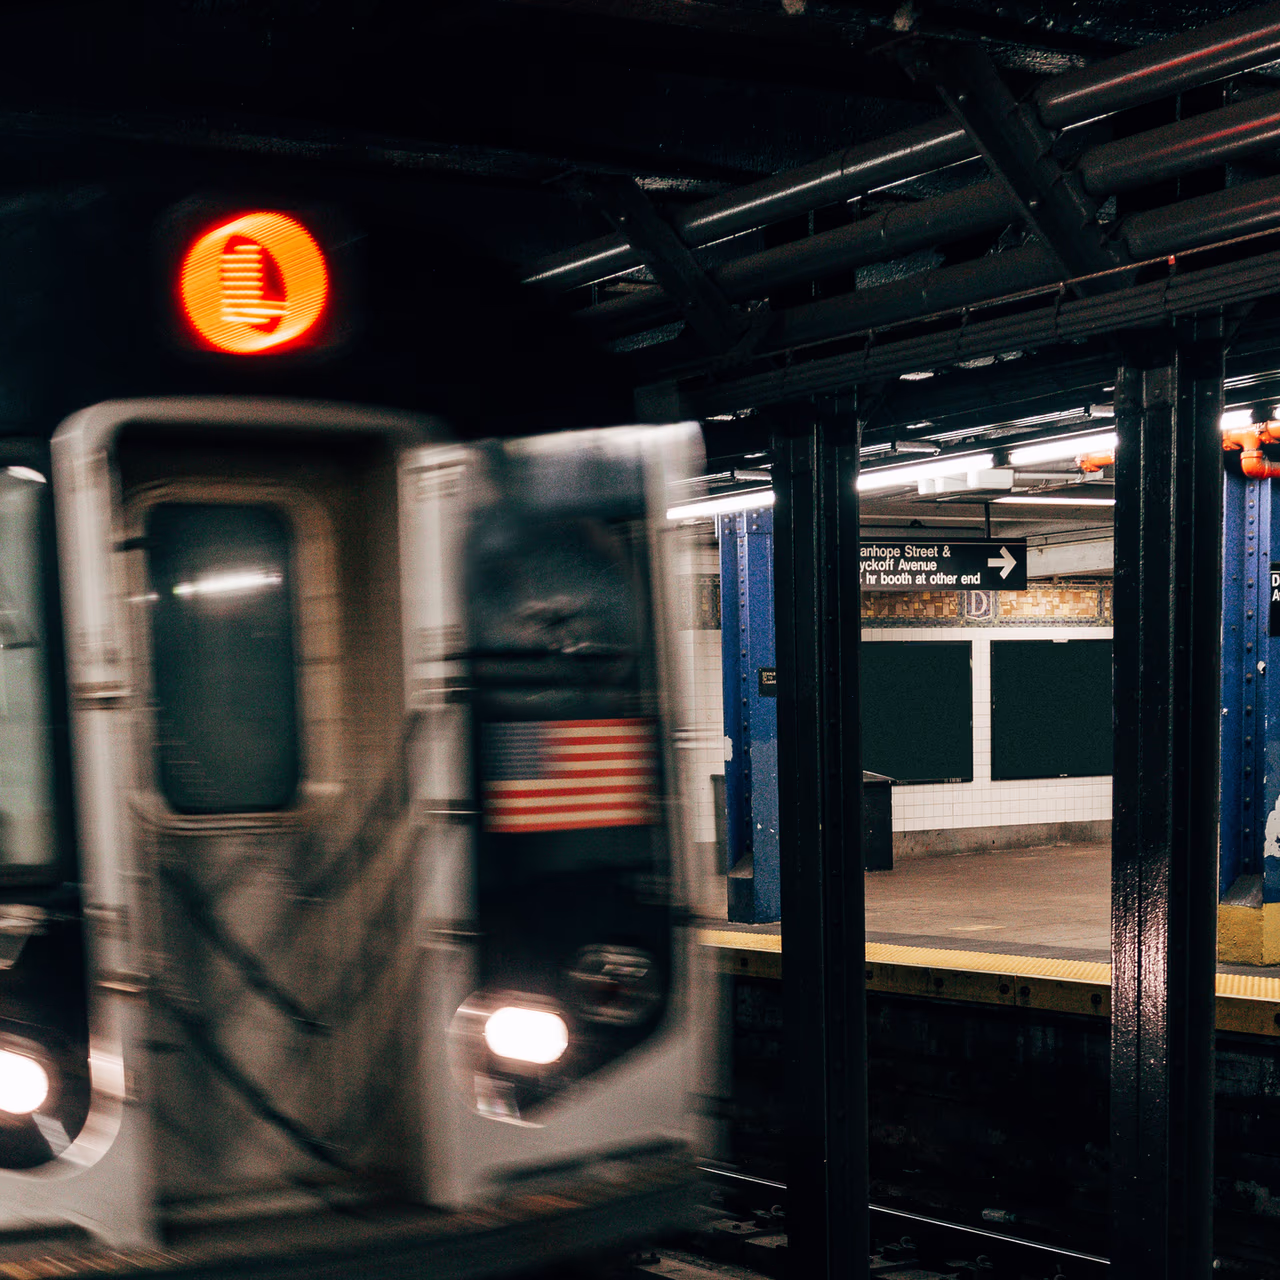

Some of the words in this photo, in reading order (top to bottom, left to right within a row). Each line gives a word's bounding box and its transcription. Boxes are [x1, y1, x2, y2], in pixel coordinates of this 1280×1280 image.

[860, 545, 901, 558] anhope
[904, 545, 939, 557] Street
[942, 545, 951, 557] &
[860, 558, 894, 572] yckoff
[898, 559, 937, 571] Avenue
[866, 572, 877, 584] hr
[881, 572, 912, 584] booth
[915, 573, 926, 584] at
[930, 572, 957, 584] other
[961, 572, 980, 584] end
[971, 590, 988, 615] D
